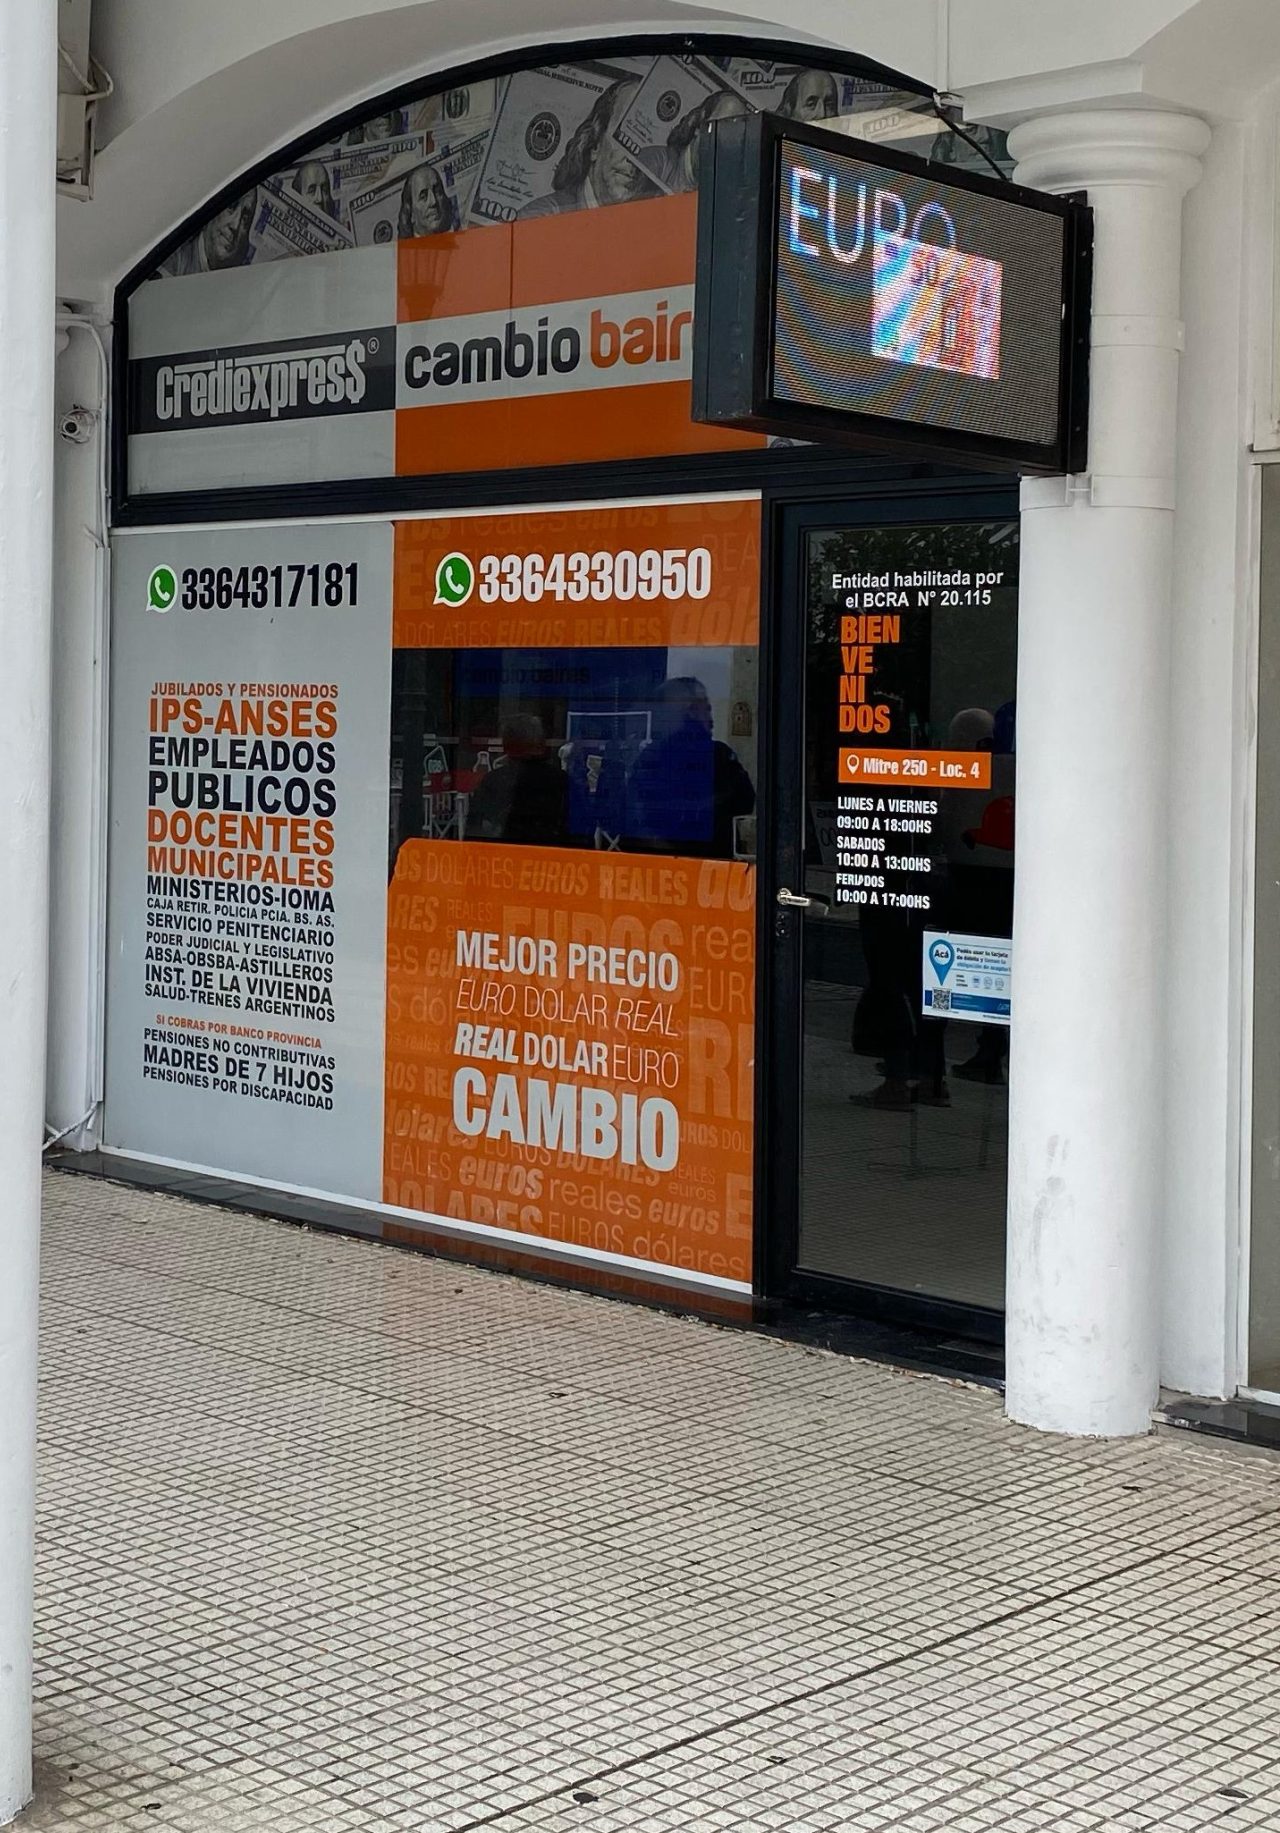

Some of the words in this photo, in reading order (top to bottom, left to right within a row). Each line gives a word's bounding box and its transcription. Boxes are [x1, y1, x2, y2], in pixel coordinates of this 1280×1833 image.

[405, 316, 580, 389] cambio
[590, 300, 693, 369] bair
[181, 562, 359, 610] 3364317181
[479, 547, 712, 604] 3364330950
[832, 572, 889, 589] Entidad
[894, 570, 970, 588] habilitada
[975, 570, 1004, 588] por
[845, 592, 858, 608] el
[863, 591, 909, 608] BCRA
[940, 589, 992, 606] 20.115
[841, 615, 900, 643] BIEN
[841, 646, 873, 673] VE
[151, 682, 223, 697] JUBILADOS
[228, 683, 236, 697] Y
[240, 683, 339, 698] PENSIONADOS
[839, 675, 865, 703] NI
[149, 698, 338, 739] IPS-ANSES
[839, 705, 891, 733] DOS
[149, 736, 336, 774] EMPLEADOS
[863, 757, 899, 775] Mitre
[902, 759, 928, 776] 250
[940, 761, 967, 778] Loc.
[970, 762, 980, 779] 4
[148, 771, 337, 818] PUBLICOS
[838, 796, 873, 812] LUNES
[876, 798, 885, 812] A
[888, 798, 938, 814] VIERNES
[148, 809, 335, 857] DOCENTES
[837, 815, 869, 830] 09:00
[872, 817, 880, 831] A
[884, 818, 932, 834] 18:00HS
[837, 835, 886, 851] SABADOS
[148, 846, 334, 889] MUNICIPALES
[837, 853, 869, 868] 10:00
[871, 854, 880, 869] A
[884, 856, 931, 872] 13:00HS
[147, 875, 335, 913] MINISTERIOS-IOMA
[599, 864, 689, 906] REALES
[836, 888, 868, 904] 10:00
[869, 891, 879, 905] A
[882, 892, 931, 910] 17:00HS
[146, 897, 174, 910] CAJA
[177, 900, 211, 915] RETIR.
[214, 903, 258, 920] POLICIA
[261, 907, 291, 923] PCIA.
[294, 911, 312, 925] BS.
[316, 913, 335, 927] AS.
[146, 911, 212, 933] SERVICIO
[217, 919, 334, 947] PENITENCIARIO
[145, 946, 333, 984] ABSA-OBSBA-ASTILLEROS
[146, 931, 183, 946] PODER
[186, 935, 240, 953] JUDICIAL
[243, 942, 251, 955] Y
[255, 943, 334, 965] LEGISLATIVO
[456, 929, 558, 978] MEJOR
[568, 942, 679, 992] PRECIO
[145, 964, 186, 986] INST.
[192, 969, 214, 989] DE
[219, 973, 240, 994] LA
[246, 977, 333, 1006] VIVIENDA
[145, 983, 241, 1009] SALUD-TRENES
[245, 997, 335, 1023] ARGENTINOS
[689, 966, 756, 1016] EUR
[456, 978, 516, 1016] EURO
[524, 985, 608, 1029] DOLAR
[614, 997, 679, 1037] REAL
[144, 1027, 210, 1050] PENSIONES
[213, 1038, 230, 1053] NO
[233, 1042, 336, 1070] CONTRIBUTIVAS
[156, 1013, 165, 1025] SI
[168, 1015, 206, 1031] COBRAS
[208, 1021, 228, 1035] POR
[230, 1025, 264, 1040] BANCO
[267, 1031, 322, 1049] PROVINCIA
[143, 1044, 218, 1074] MADRES
[225, 1057, 250, 1079] DE
[256, 1062, 267, 1082] 7
[273, 1065, 334, 1094] HIJOS
[453, 1022, 519, 1064] REAL
[523, 1031, 608, 1077] DOLAR
[613, 1044, 679, 1089] EURO
[143, 1066, 209, 1089] PENSIONES
[213, 1077, 237, 1094] POR
[241, 1082, 333, 1111] DISCAPACIDAD
[452, 1066, 680, 1173] CAMBIO
[459, 1155, 545, 1200] euros
[550, 1178, 642, 1220] reales
[648, 1198, 721, 1236] euros
[633, 1230, 745, 1280] dólares
